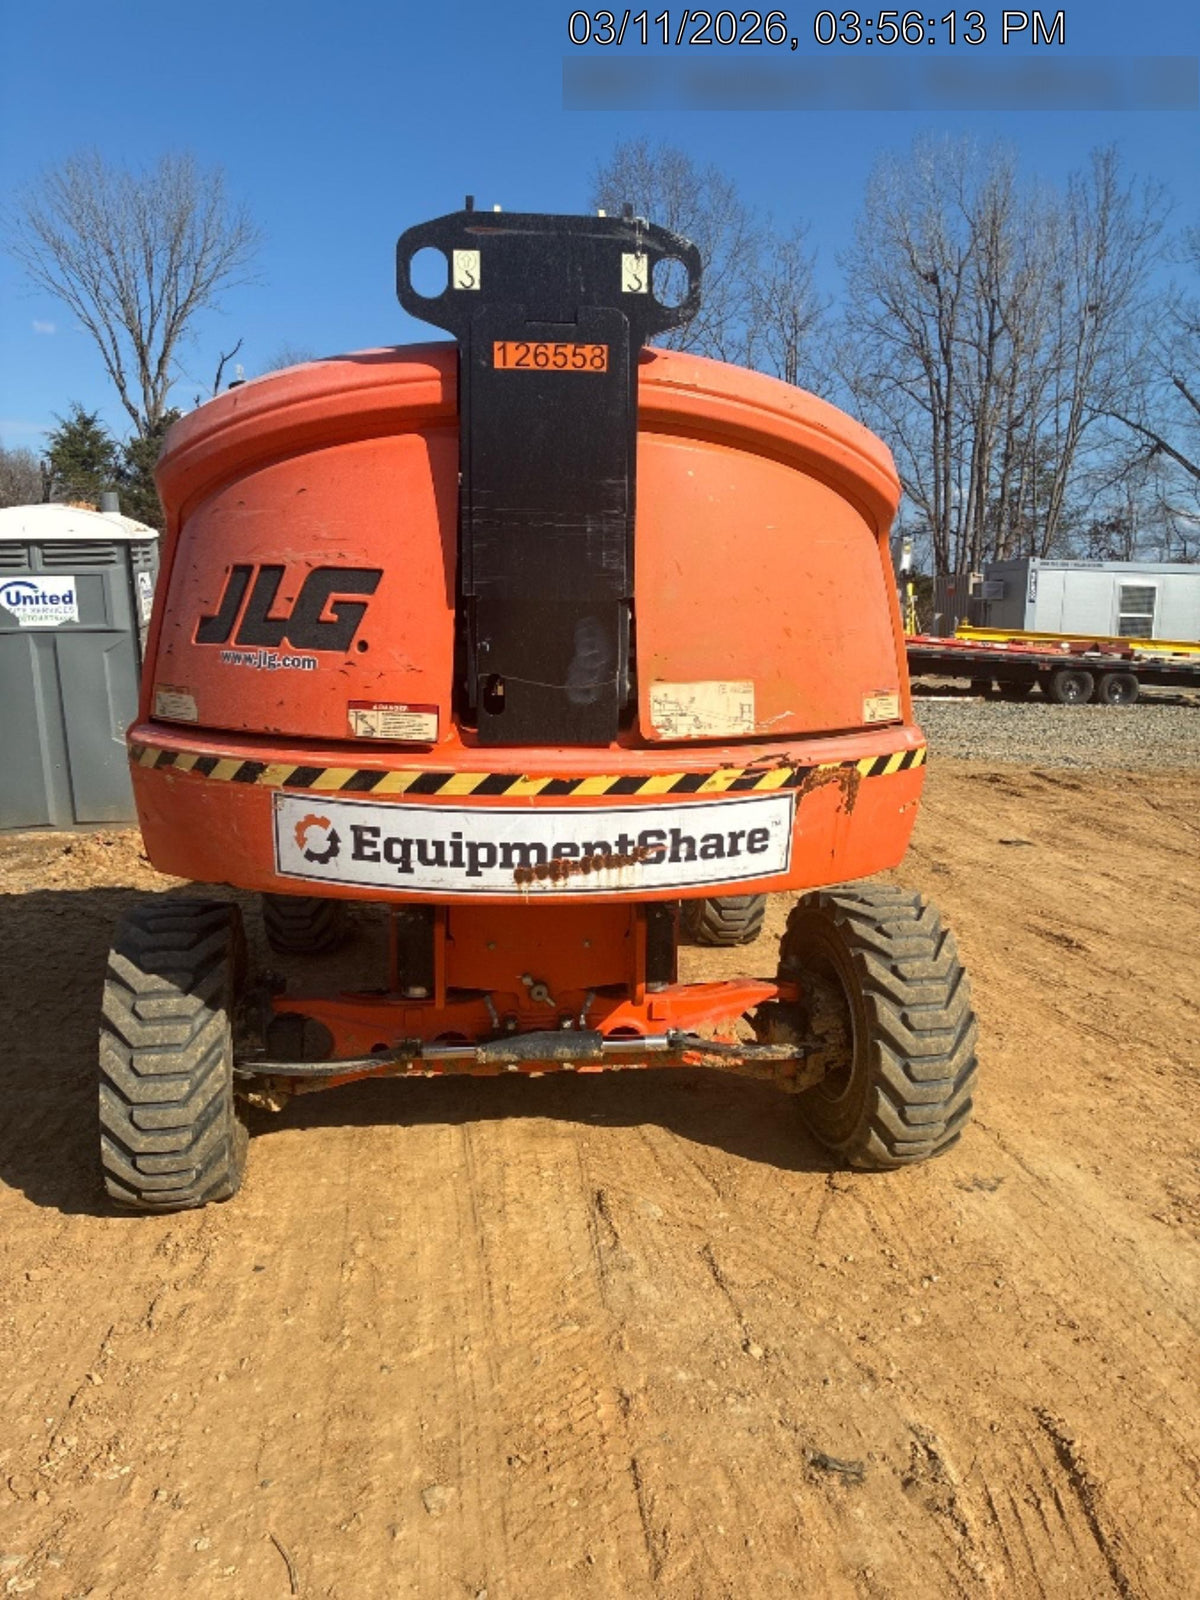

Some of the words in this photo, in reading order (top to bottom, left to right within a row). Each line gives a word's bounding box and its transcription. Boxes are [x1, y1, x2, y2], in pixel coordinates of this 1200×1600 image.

[496, 343, 606, 370] 126558
[5, 589, 74, 607] United
[220, 650, 317, 670] www.jlg.com
[349, 823, 771, 876] EquipmentShare
